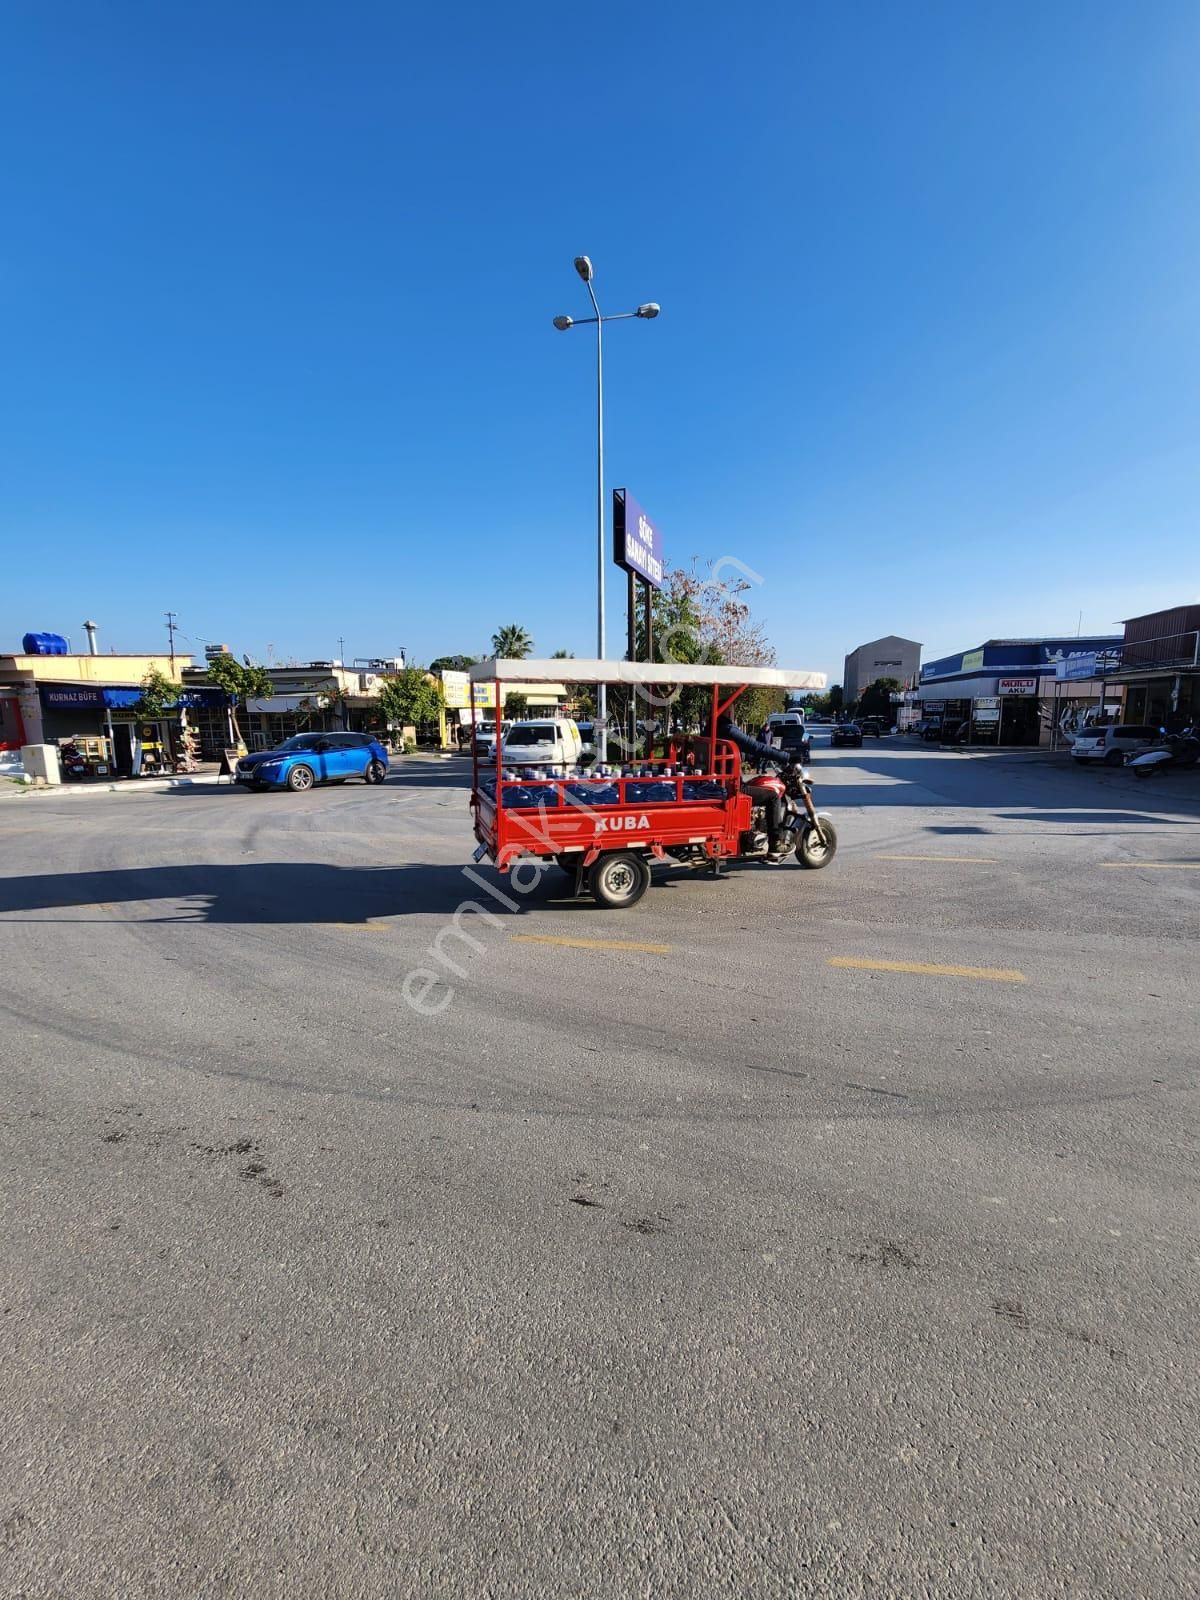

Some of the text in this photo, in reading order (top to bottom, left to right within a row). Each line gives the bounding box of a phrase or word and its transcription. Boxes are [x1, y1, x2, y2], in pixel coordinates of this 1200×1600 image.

[639, 514, 653, 549] SÖKE
[49, 691, 97, 702] KURNAZ BÜFE
[595, 815, 650, 832] KUBA
